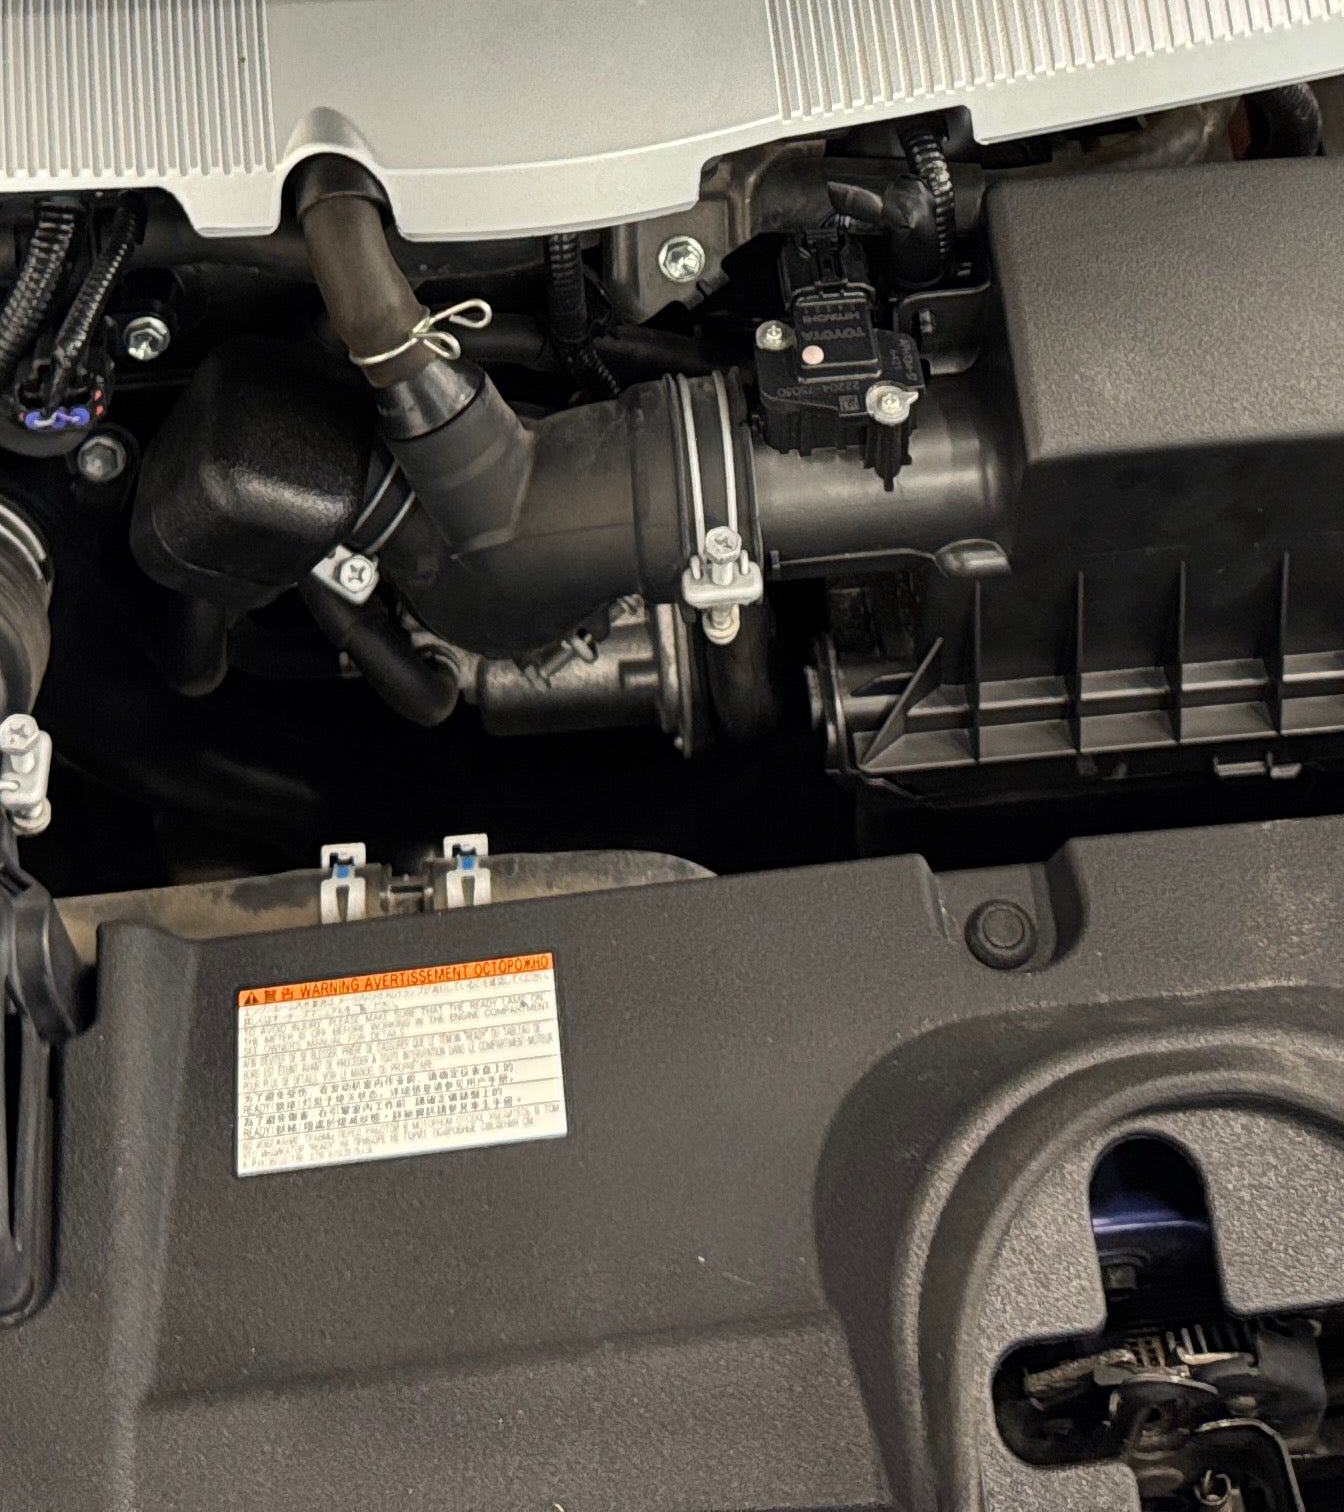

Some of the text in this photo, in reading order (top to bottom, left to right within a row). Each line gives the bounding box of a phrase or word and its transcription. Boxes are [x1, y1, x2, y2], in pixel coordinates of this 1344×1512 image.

[801, 326, 867, 341] TOYOTA
[300, 977, 360, 998] WARNING
[363, 964, 467, 990] AVERTISSEMENT
